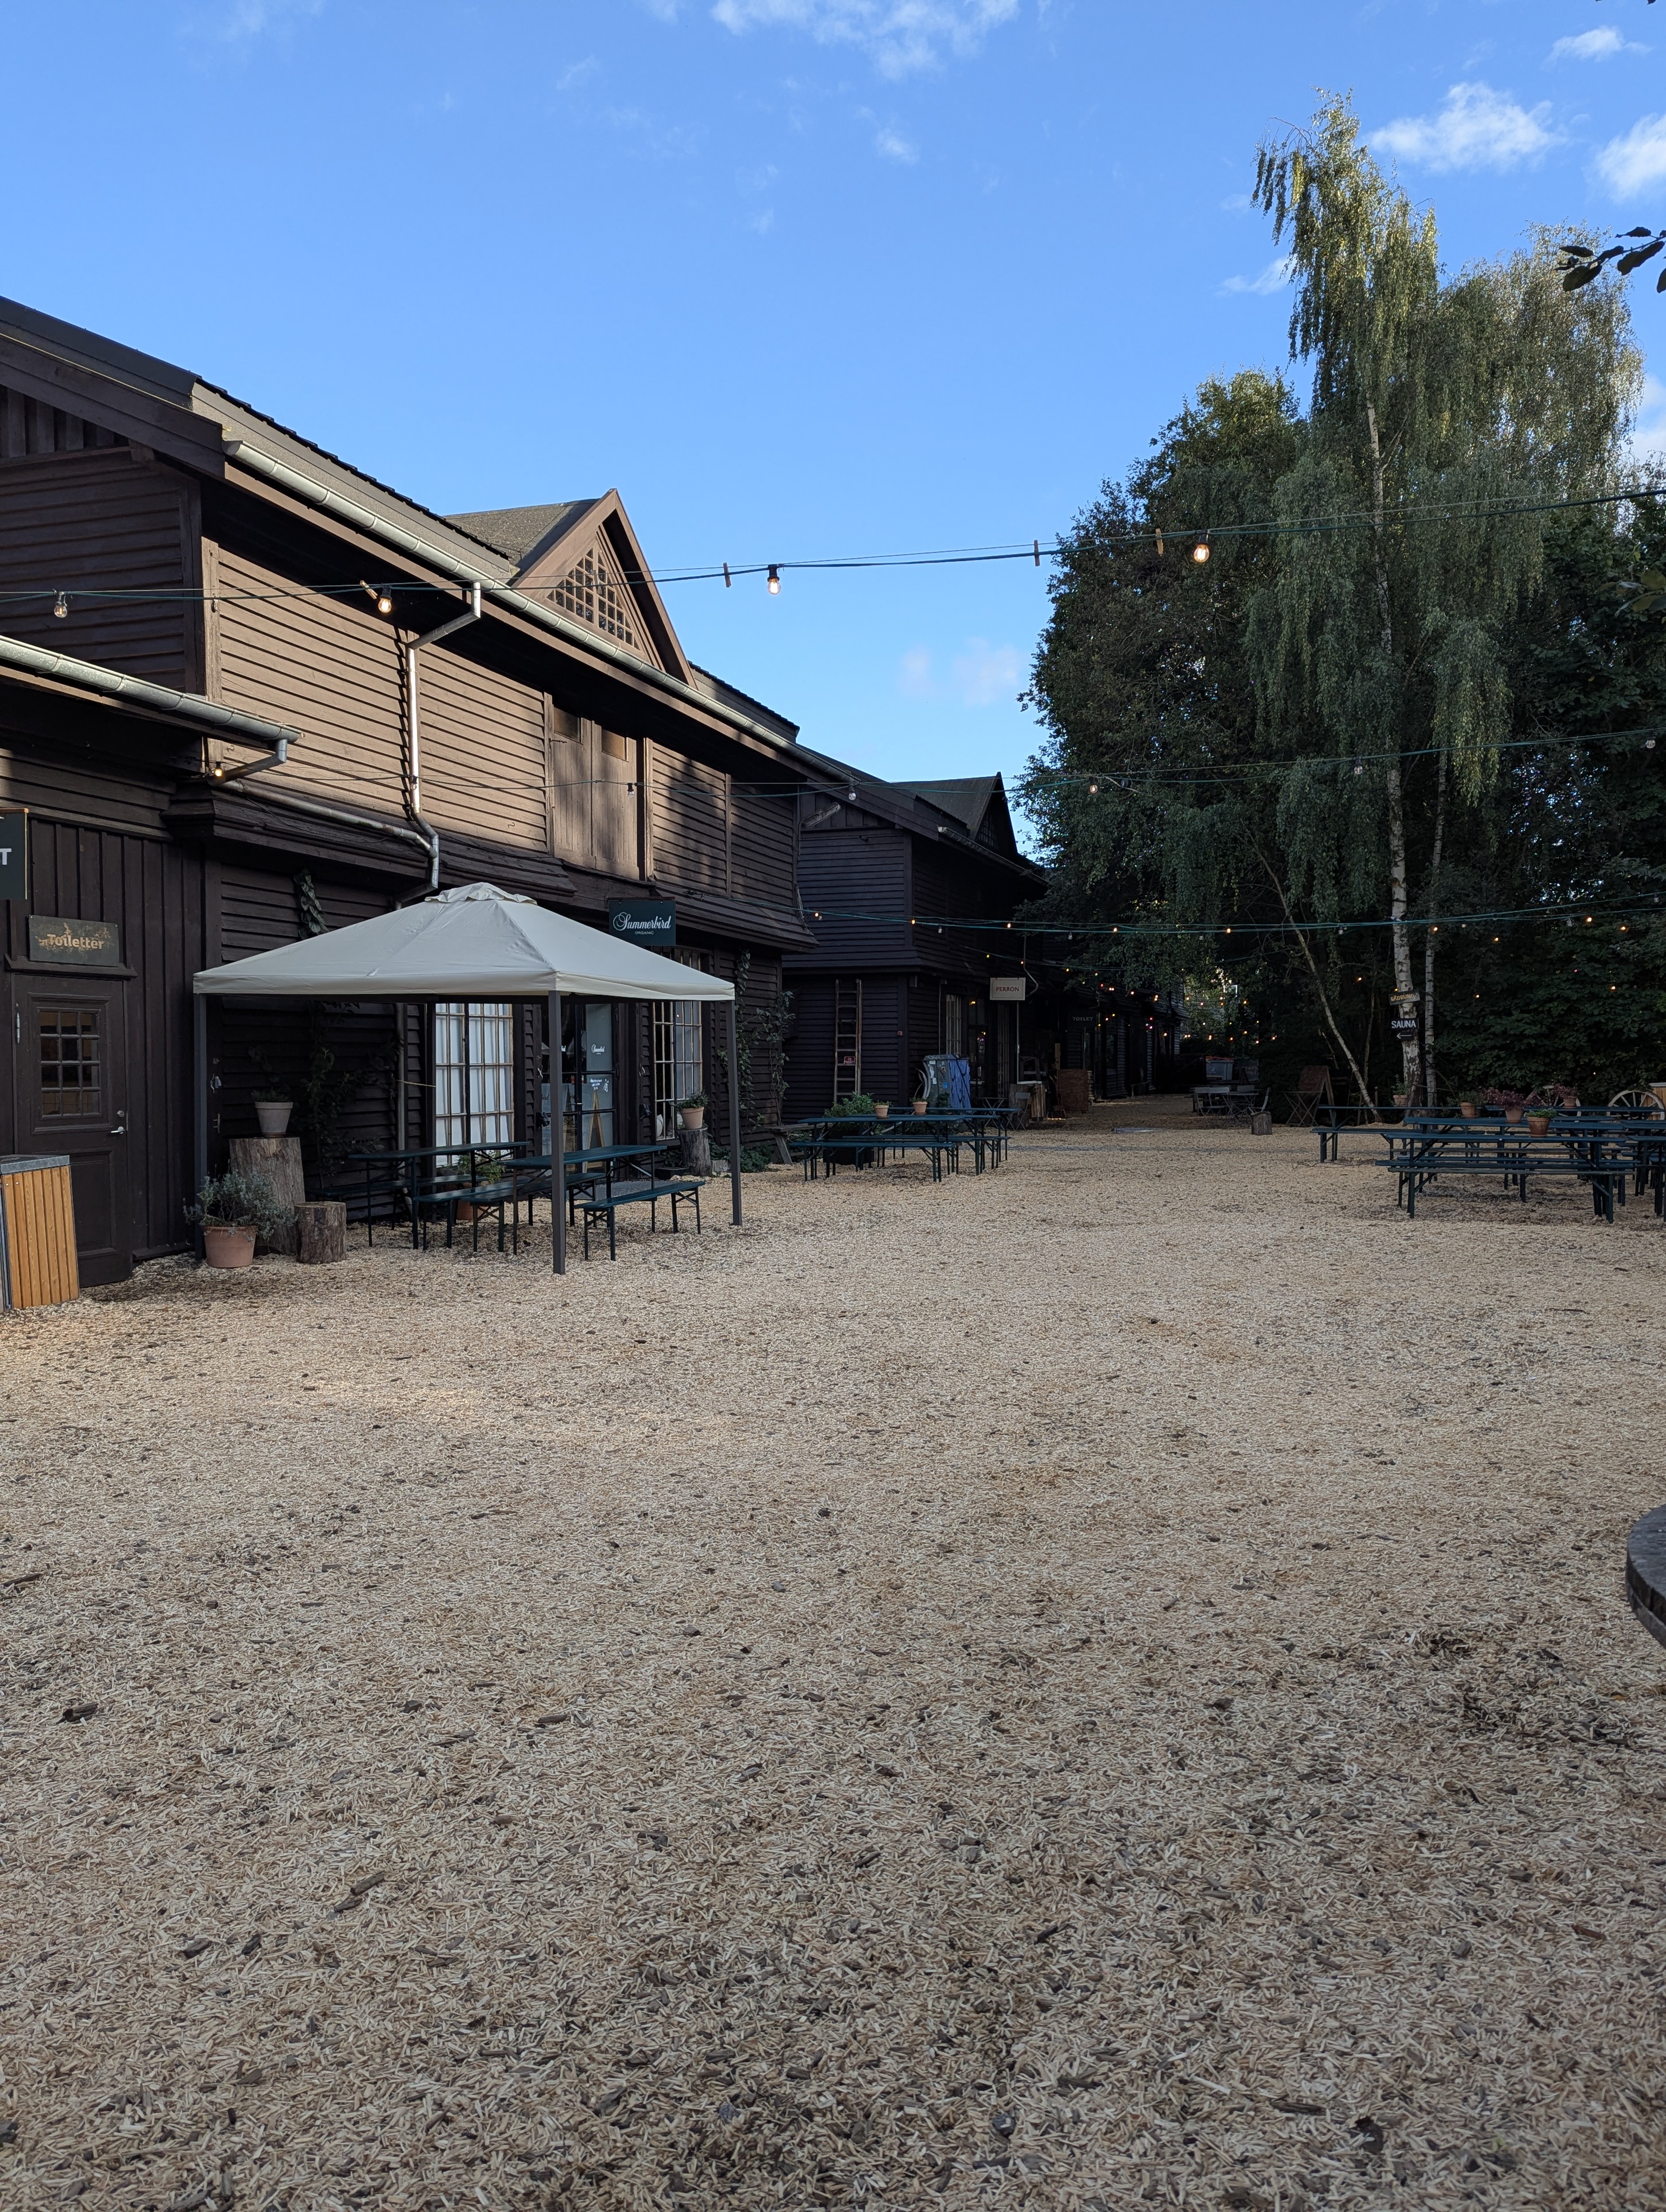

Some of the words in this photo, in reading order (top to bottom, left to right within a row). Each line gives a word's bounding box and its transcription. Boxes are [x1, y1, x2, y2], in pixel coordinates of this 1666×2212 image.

[613, 912, 671, 931] Summerbird
[47, 934, 104, 949] Toiletter
[1391, 1020, 1416, 1028] SAUNA
